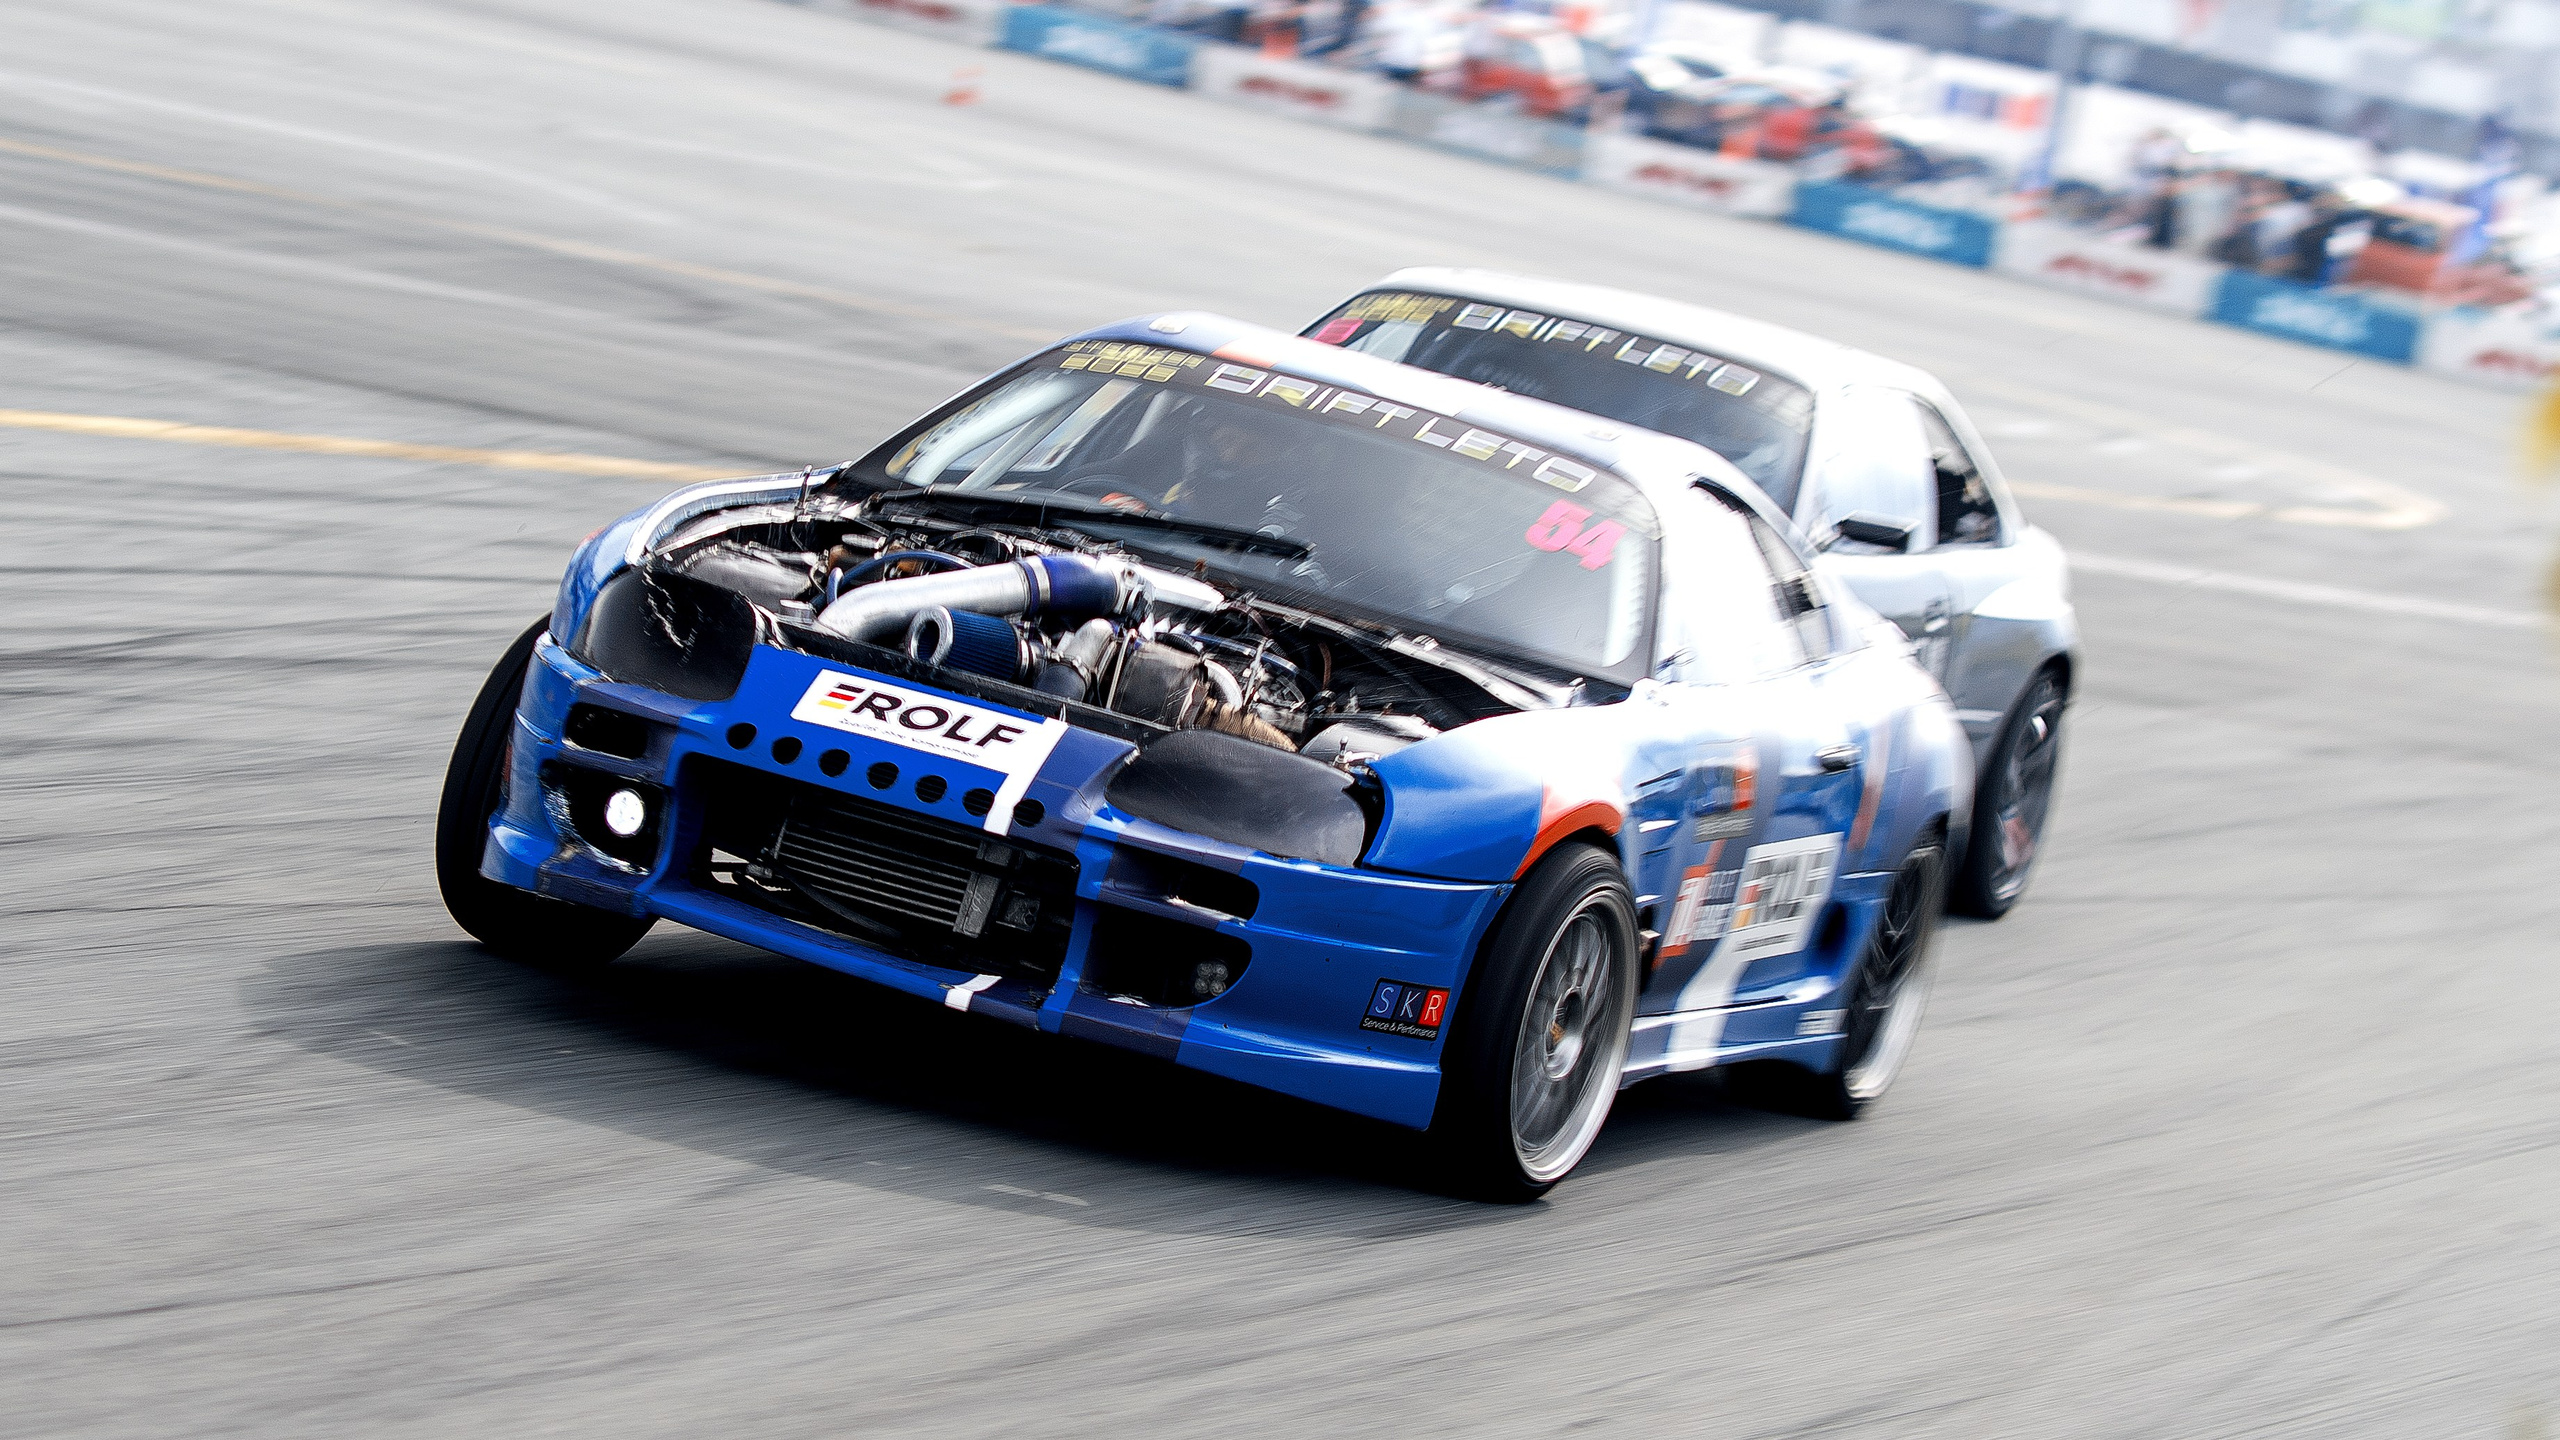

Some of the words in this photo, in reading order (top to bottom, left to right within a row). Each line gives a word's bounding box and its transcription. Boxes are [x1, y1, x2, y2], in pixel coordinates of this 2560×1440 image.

[1452, 302, 1621, 353] DRIFT
[1614, 336, 1762, 397] LETO
[1205, 362, 1417, 429] DRIFT
[1413, 417, 1597, 494] LETO
[1525, 498, 1628, 572] 54
[850, 691, 1025, 748] ROLF
[1362, 1017, 1389, 1031] Service
[1375, 986, 1443, 1022] SKR
